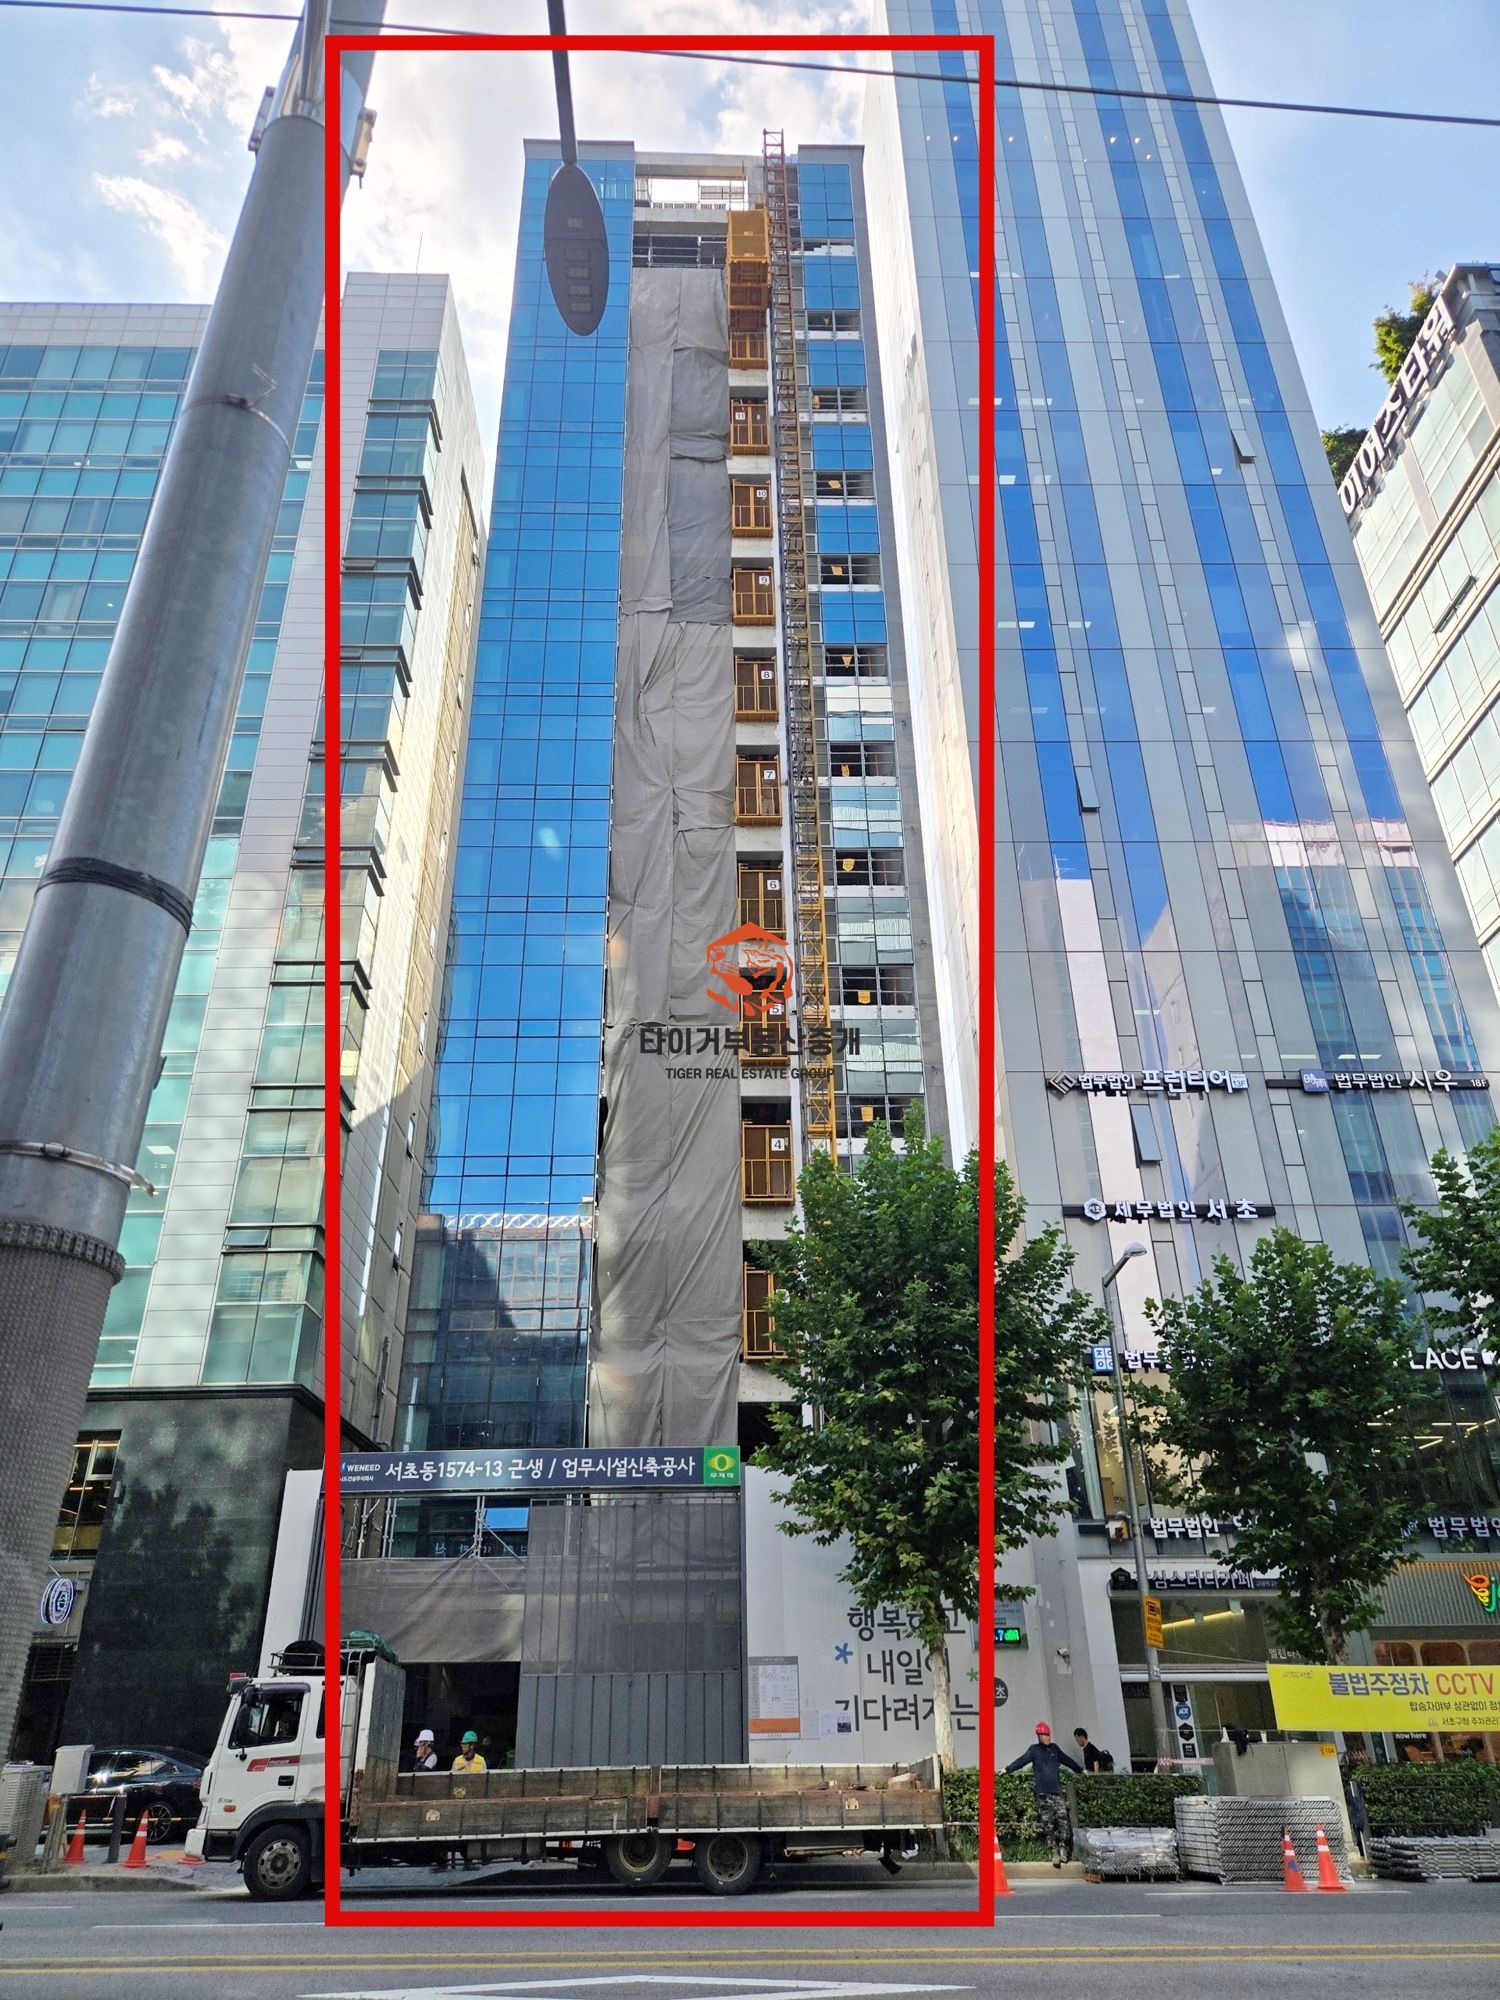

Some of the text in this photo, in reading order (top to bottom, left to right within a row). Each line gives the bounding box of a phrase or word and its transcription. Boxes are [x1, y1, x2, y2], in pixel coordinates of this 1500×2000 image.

[1078, 1073, 1137, 1090] 법무법인
[1141, 1069, 1233, 1094] 프런티어
[1334, 1069, 1488, 1093] 법무법인 시우 18F
[1114, 1198, 1259, 1220] 세무법인 서초
[347, 1463, 381, 1472] WENEED
[385, 1455, 695, 1482] 서초동1574-13 근생 / 업무시설신축공사
[1150, 1517, 1221, 1539] 법무법인
[1134, 1570, 1255, 1590] 심스터디카페
[1328, 1672, 1494, 1696] 불법주정차 CCTV
[1409, 1701, 1451, 1712] 탑승자여부
[1454, 1701, 1487, 1712] 상관없이
[1442, 1716, 1469, 1726] 서초구청
